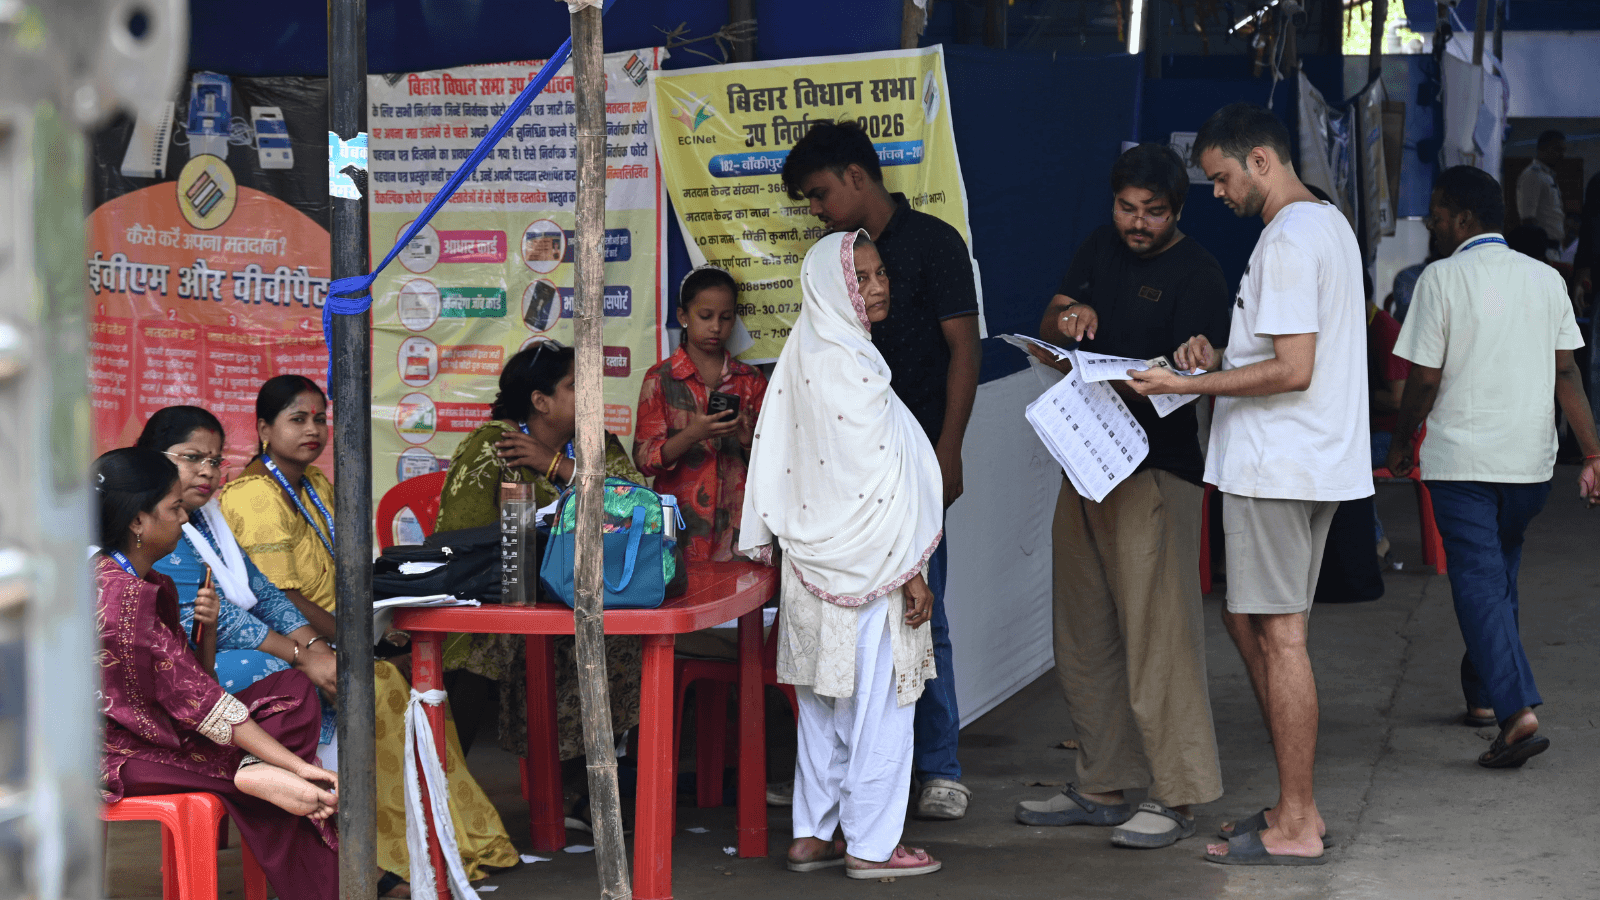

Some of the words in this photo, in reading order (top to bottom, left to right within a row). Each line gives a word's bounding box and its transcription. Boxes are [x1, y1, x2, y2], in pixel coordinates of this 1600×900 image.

[408, 73, 440, 96] बिहार
[443, 73, 477, 95] विधान
[479, 78, 505, 95] सभा
[507, 77, 526, 94] उप
[727, 83, 788, 113] बिहार
[793, 77, 863, 108] विधान
[870, 77, 917, 102] सभा
[380, 103, 394, 117] लिए
[396, 103, 412, 117] सभी
[414, 102, 442, 117] निर्वाचक
[444, 102, 461, 116] जिन्हें
[462, 102, 488, 117] निर्वाचक
[546, 101, 563, 115] जारी
[632, 101, 648, 113] स्थल
[372, 128, 382, 139] पर
[516, 124, 546, 142] सुनिश्चित
[548, 123, 567, 137] करने
[631, 120, 648, 134] फोटो
[743, 123, 766, 147] उप
[772, 112, 834, 145] निर्वा
[678, 135, 716, 146] ECINet
[373, 149, 395, 161] पहचान
[398, 149, 409, 161] पत्र
[411, 146, 436, 160] दिखाने
[438, 148, 449, 159] का
[497, 148, 510, 159] गया
[523, 145, 536, 159] ऐसे
[539, 145, 567, 159] निर्वाचक
[630, 142, 648, 156] फोटो
[742, 156, 783, 172] बाँकीपुर
[373, 171, 396, 182] पहचान
[398, 171, 408, 182] पत्र
[409, 171, 429, 185] प्रस्तुत
[431, 167, 445, 181] नहीं
[494, 167, 511, 181] अपनी
[405, 190, 422, 204] फोटो
[506, 193, 519, 203] एक
[520, 189, 547, 203] दस्तावेज
[548, 192, 567, 206] प्रस्तुत
[682, 188, 709, 198] मतदान
[710, 184, 731, 197] केन्द्र
[732, 183, 765, 196] संख्या-
[685, 211, 714, 223] मतदान
[713, 208, 733, 221] केन्द्र
[734, 209, 748, 219] का
[749, 208, 770, 218] नाम
[126, 223, 156, 246] कैसे
[158, 226, 180, 248] करें
[182, 233, 221, 252] अपना
[224, 236, 287, 256] मतदान?
[444, 239, 475, 254] आधार
[476, 235, 497, 254] कार्ड
[708, 235, 719, 245] का
[768, 228, 801, 245] कुमारी,
[735, 257, 751, 267] पता
[87, 251, 170, 295] ईवीएम
[178, 258, 226, 301] और
[100, 304, 105, 315] 1
[168, 309, 176, 320] 2
[229, 315, 236, 327] 3
[300, 319, 309, 330] 4
[275, 469, 290, 487] INDIA
